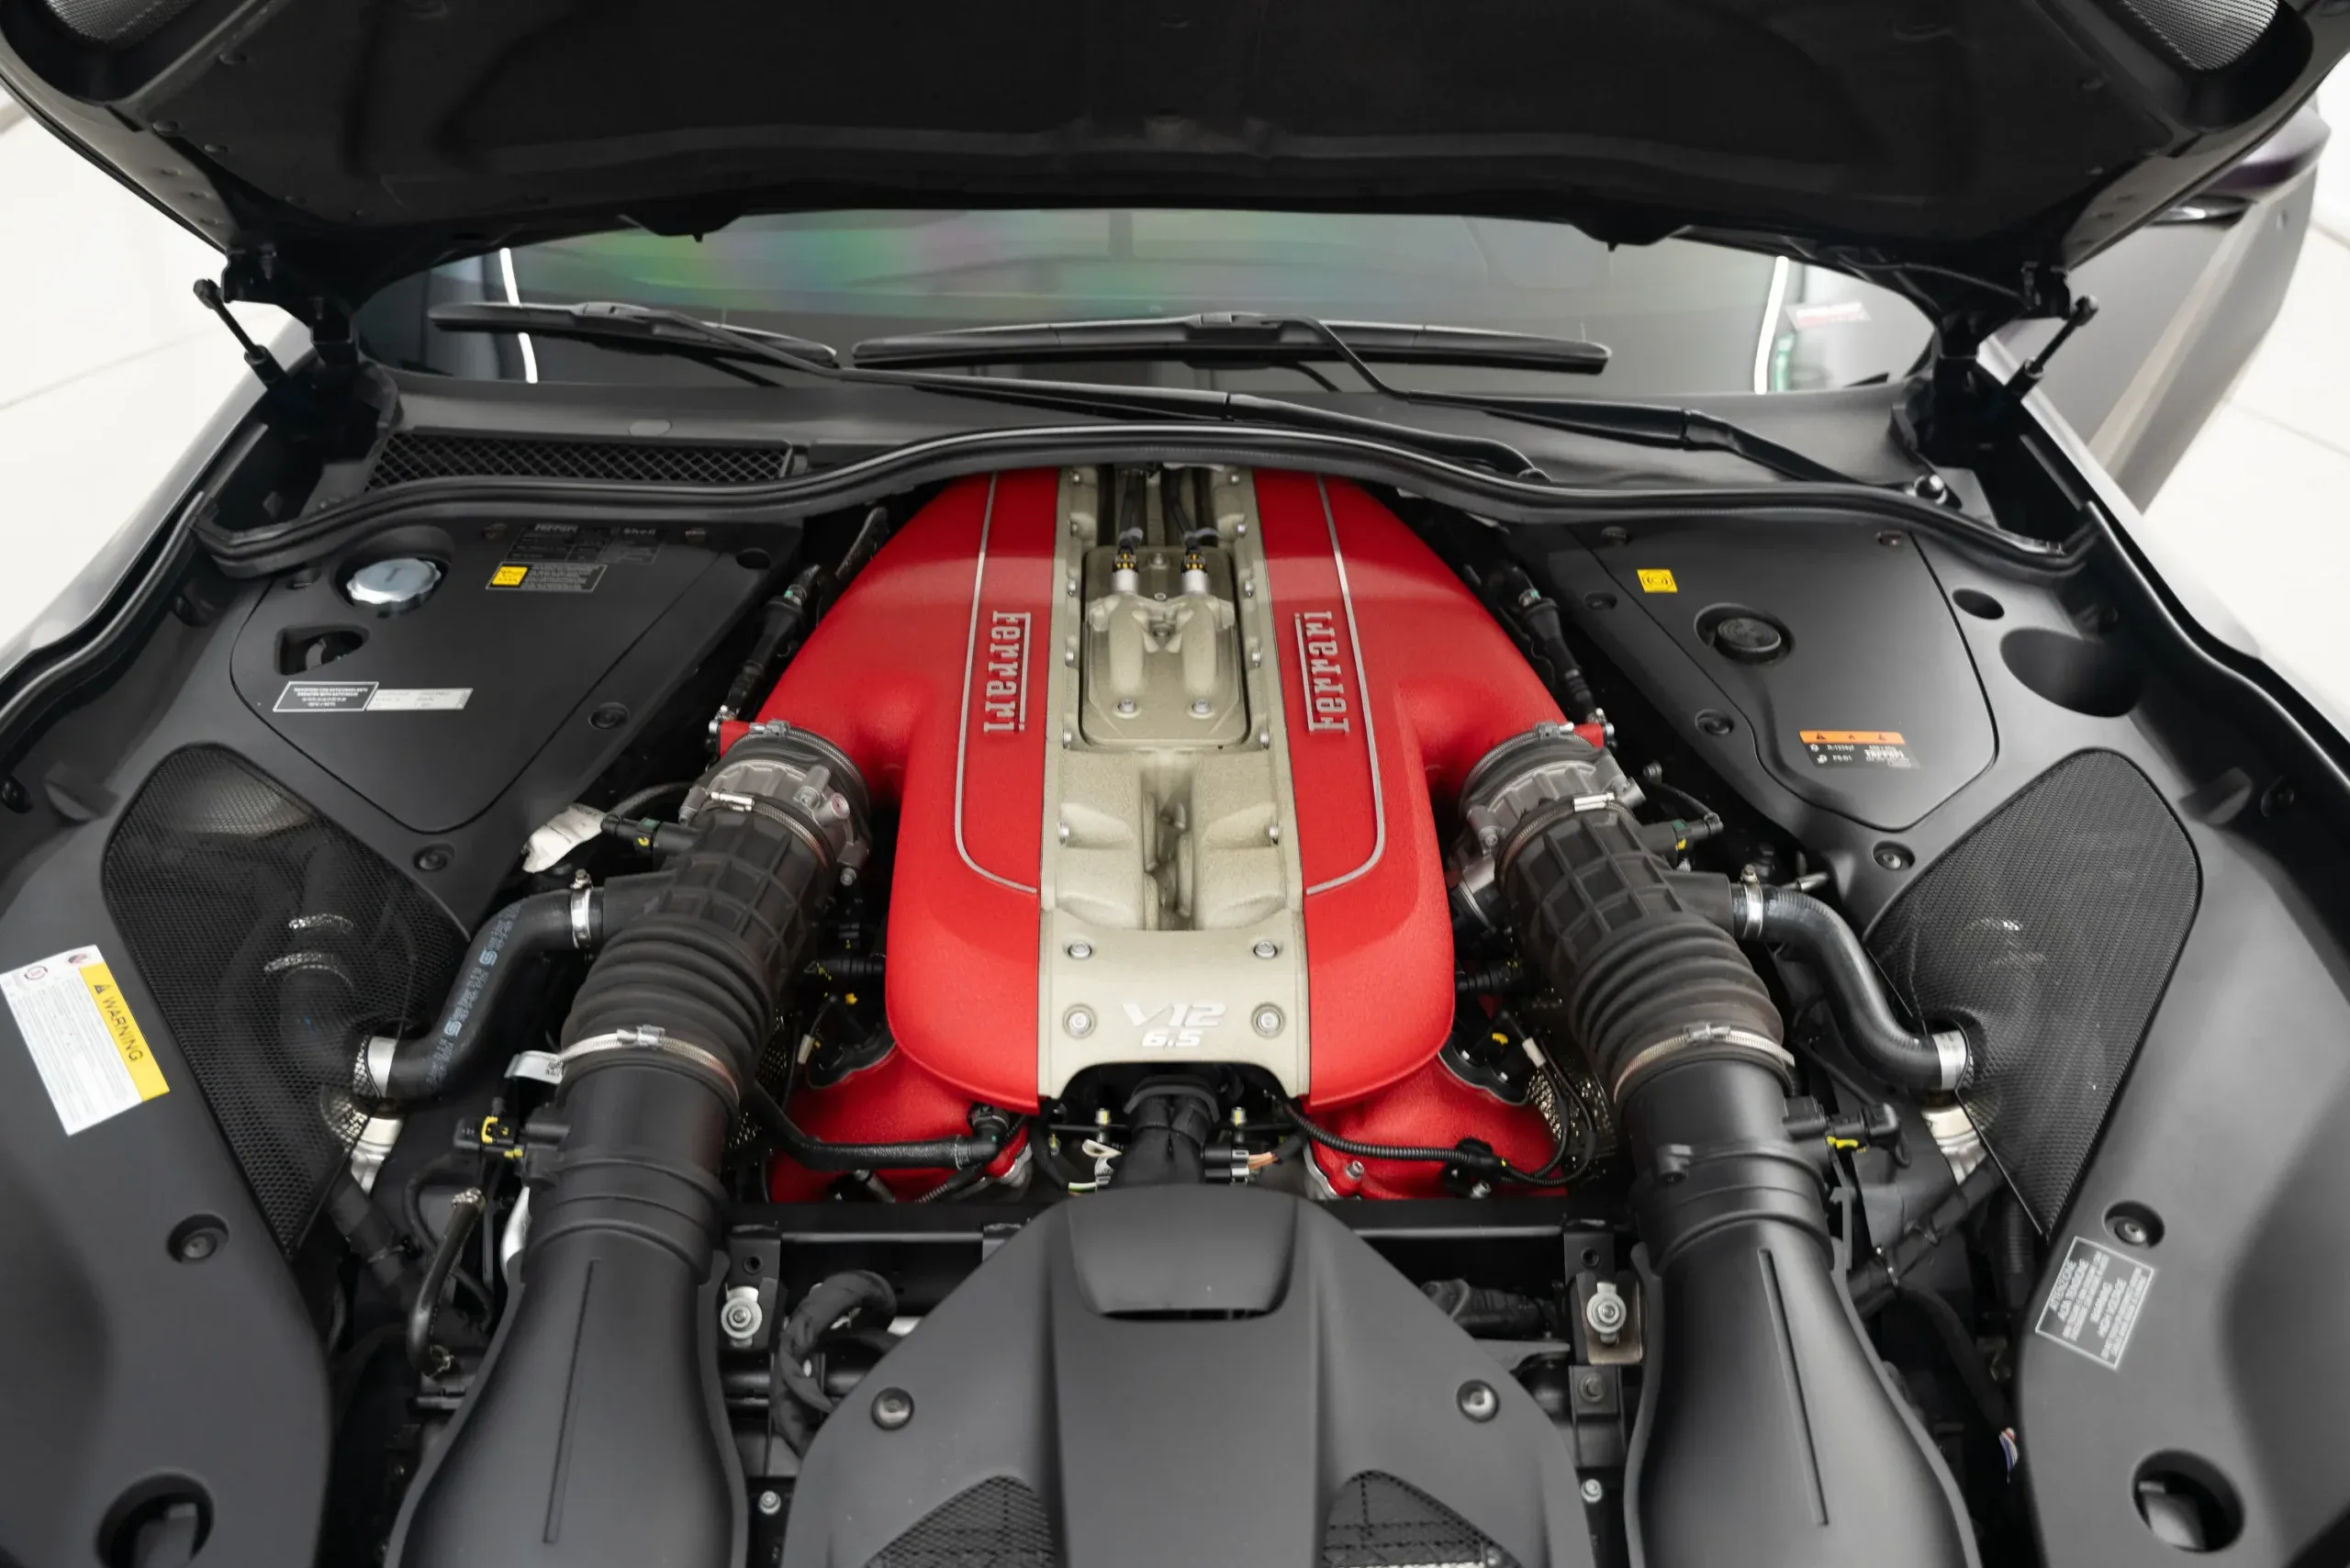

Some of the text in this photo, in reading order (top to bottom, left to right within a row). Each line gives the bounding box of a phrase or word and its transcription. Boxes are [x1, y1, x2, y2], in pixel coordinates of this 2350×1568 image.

[983, 610, 1031, 733] Ferrari
[1294, 610, 1349, 734] Ferrari
[103, 995, 144, 1062] WARNING
[1121, 1002, 1226, 1027] V12
[1141, 1029, 1203, 1047] 6.5
